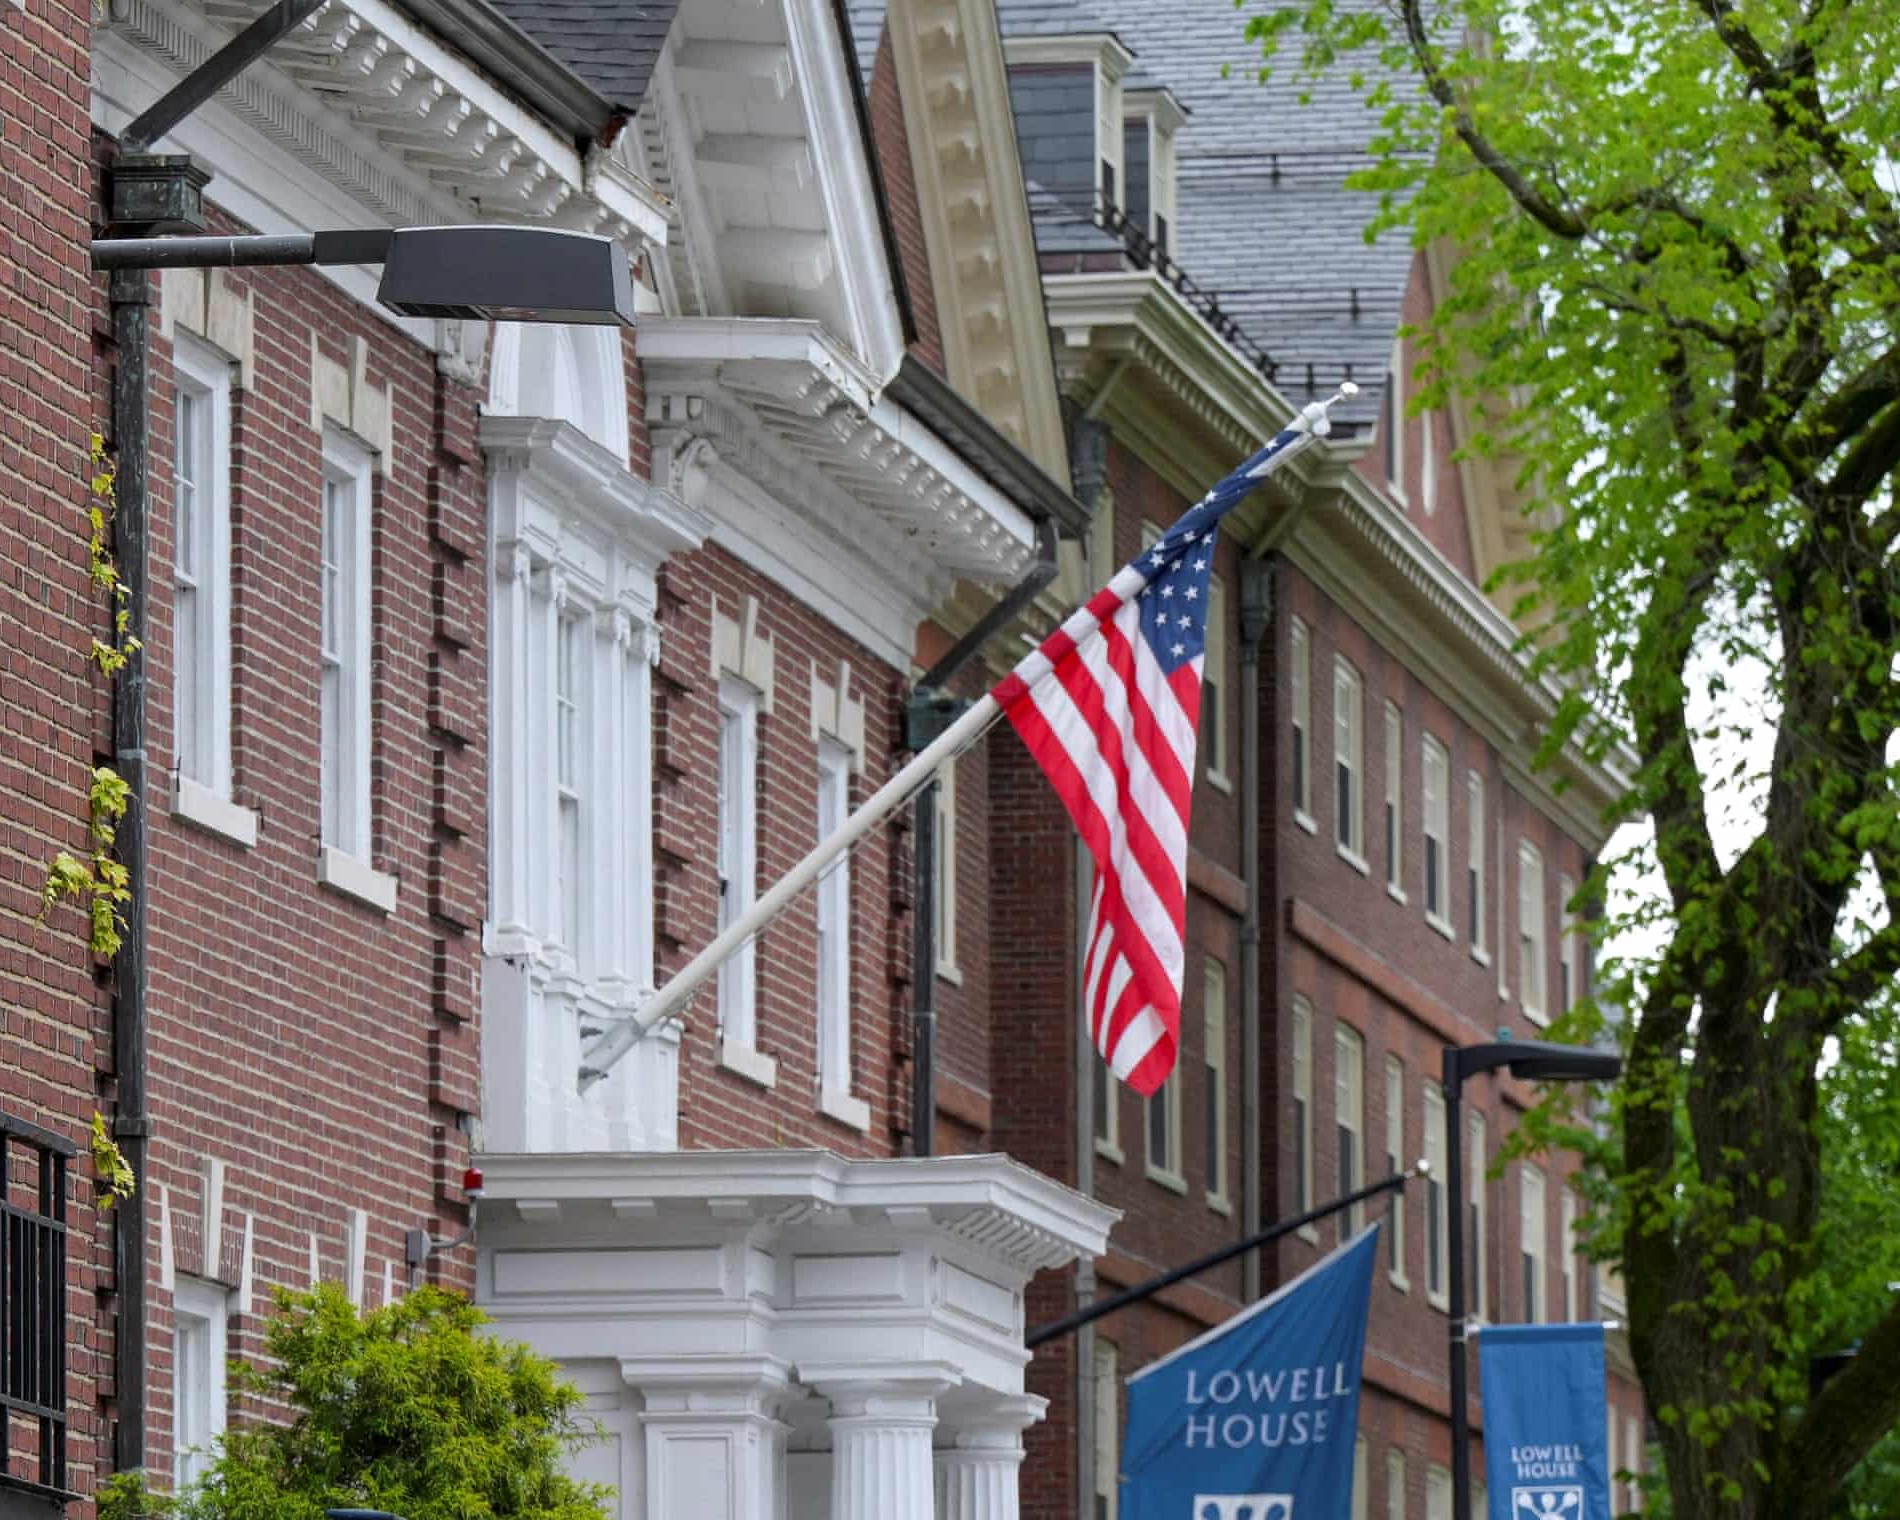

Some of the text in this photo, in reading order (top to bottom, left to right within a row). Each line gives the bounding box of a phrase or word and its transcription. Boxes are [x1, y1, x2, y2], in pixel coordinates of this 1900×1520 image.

[1186, 1362, 1351, 1404] LOWELL
[1185, 1409, 1328, 1449] HOUSE
[1510, 1444, 1583, 1463] LOWELL
